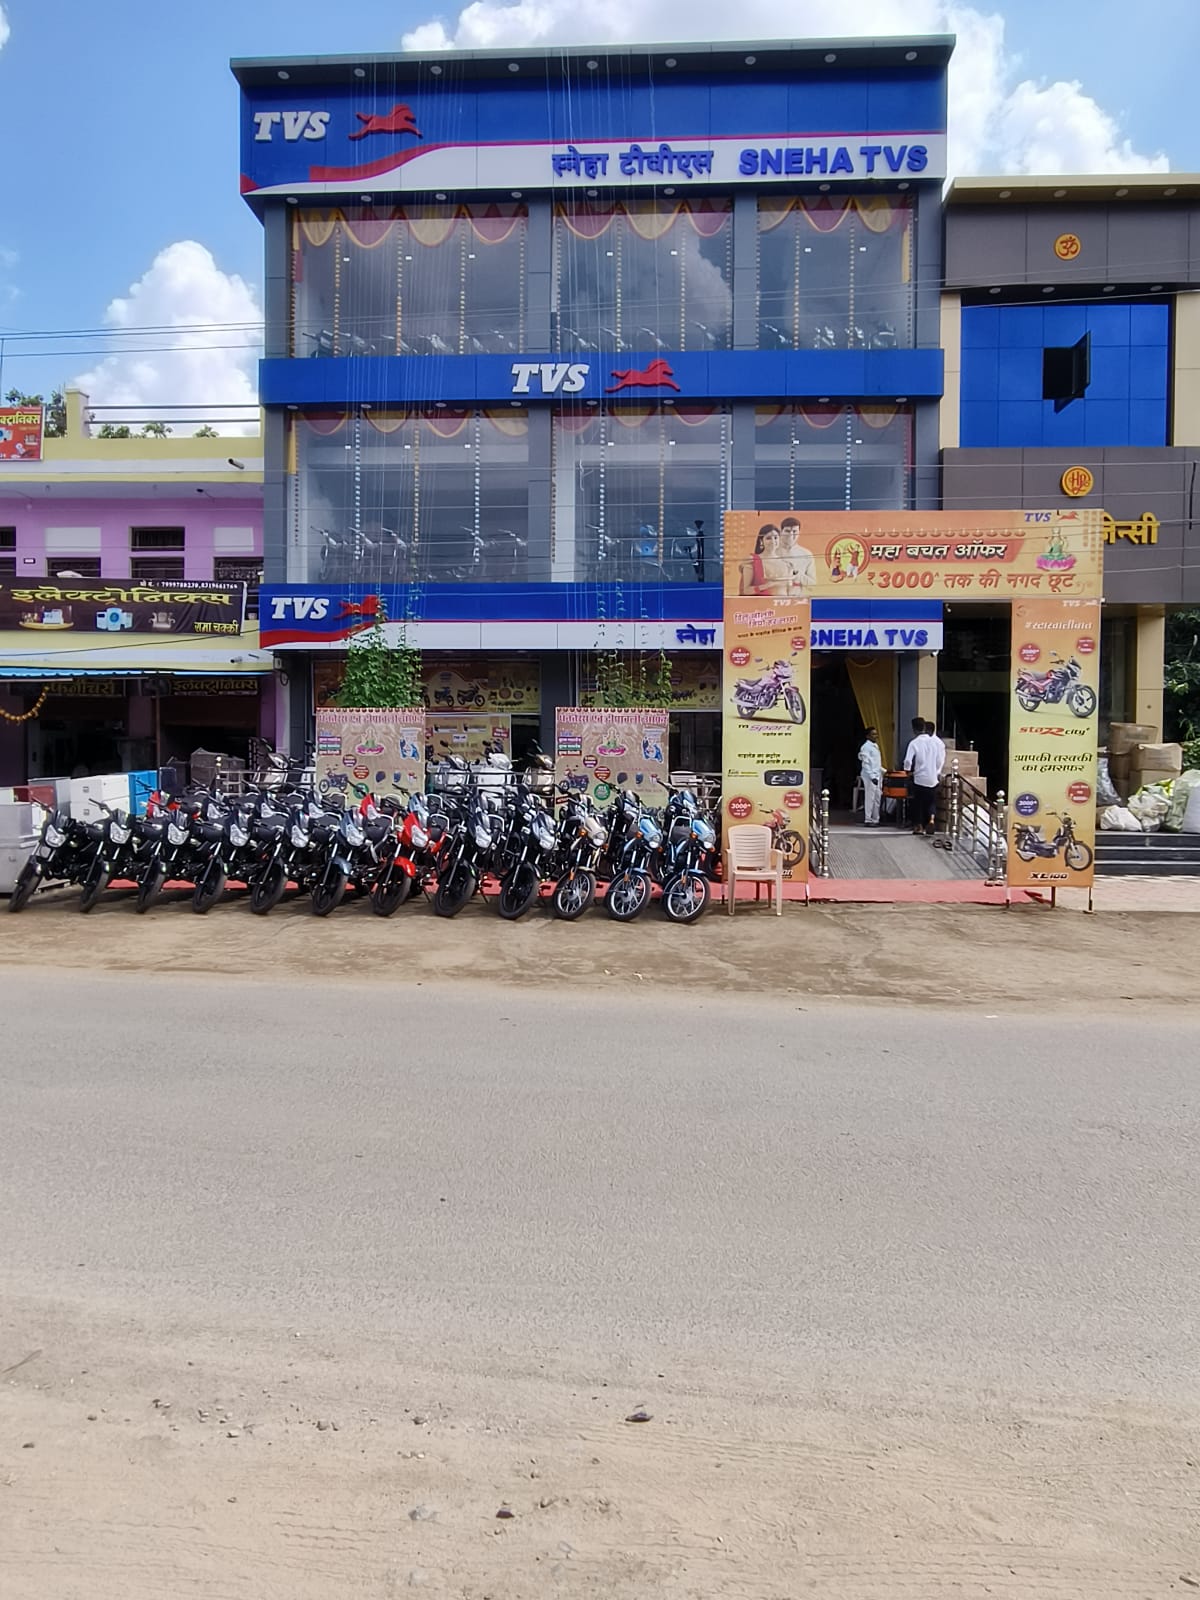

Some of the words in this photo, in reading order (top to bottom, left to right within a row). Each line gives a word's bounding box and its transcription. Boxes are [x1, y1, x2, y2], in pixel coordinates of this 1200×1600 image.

[253, 111, 330, 142] TVS
[552, 145, 609, 179] स्नेहा
[619, 144, 714, 179] टीवीएस
[739, 147, 854, 175] SNEHA
[859, 145, 929, 172] TVS
[511, 363, 590, 393] TVS
[1024, 512, 1051, 522] TVS
[870, 543, 902, 561] महा
[906, 543, 949, 561] बचत
[954, 540, 1007, 560] ऑफर
[943, 573, 973, 588] तक
[978, 569, 1001, 588] की
[1006, 572, 1042, 588] नगद
[1048, 571, 1076, 592] छूट
[271, 597, 330, 620] TVS
[676, 624, 716, 646] स्नेहा
[884, 629, 928, 647] TVS
